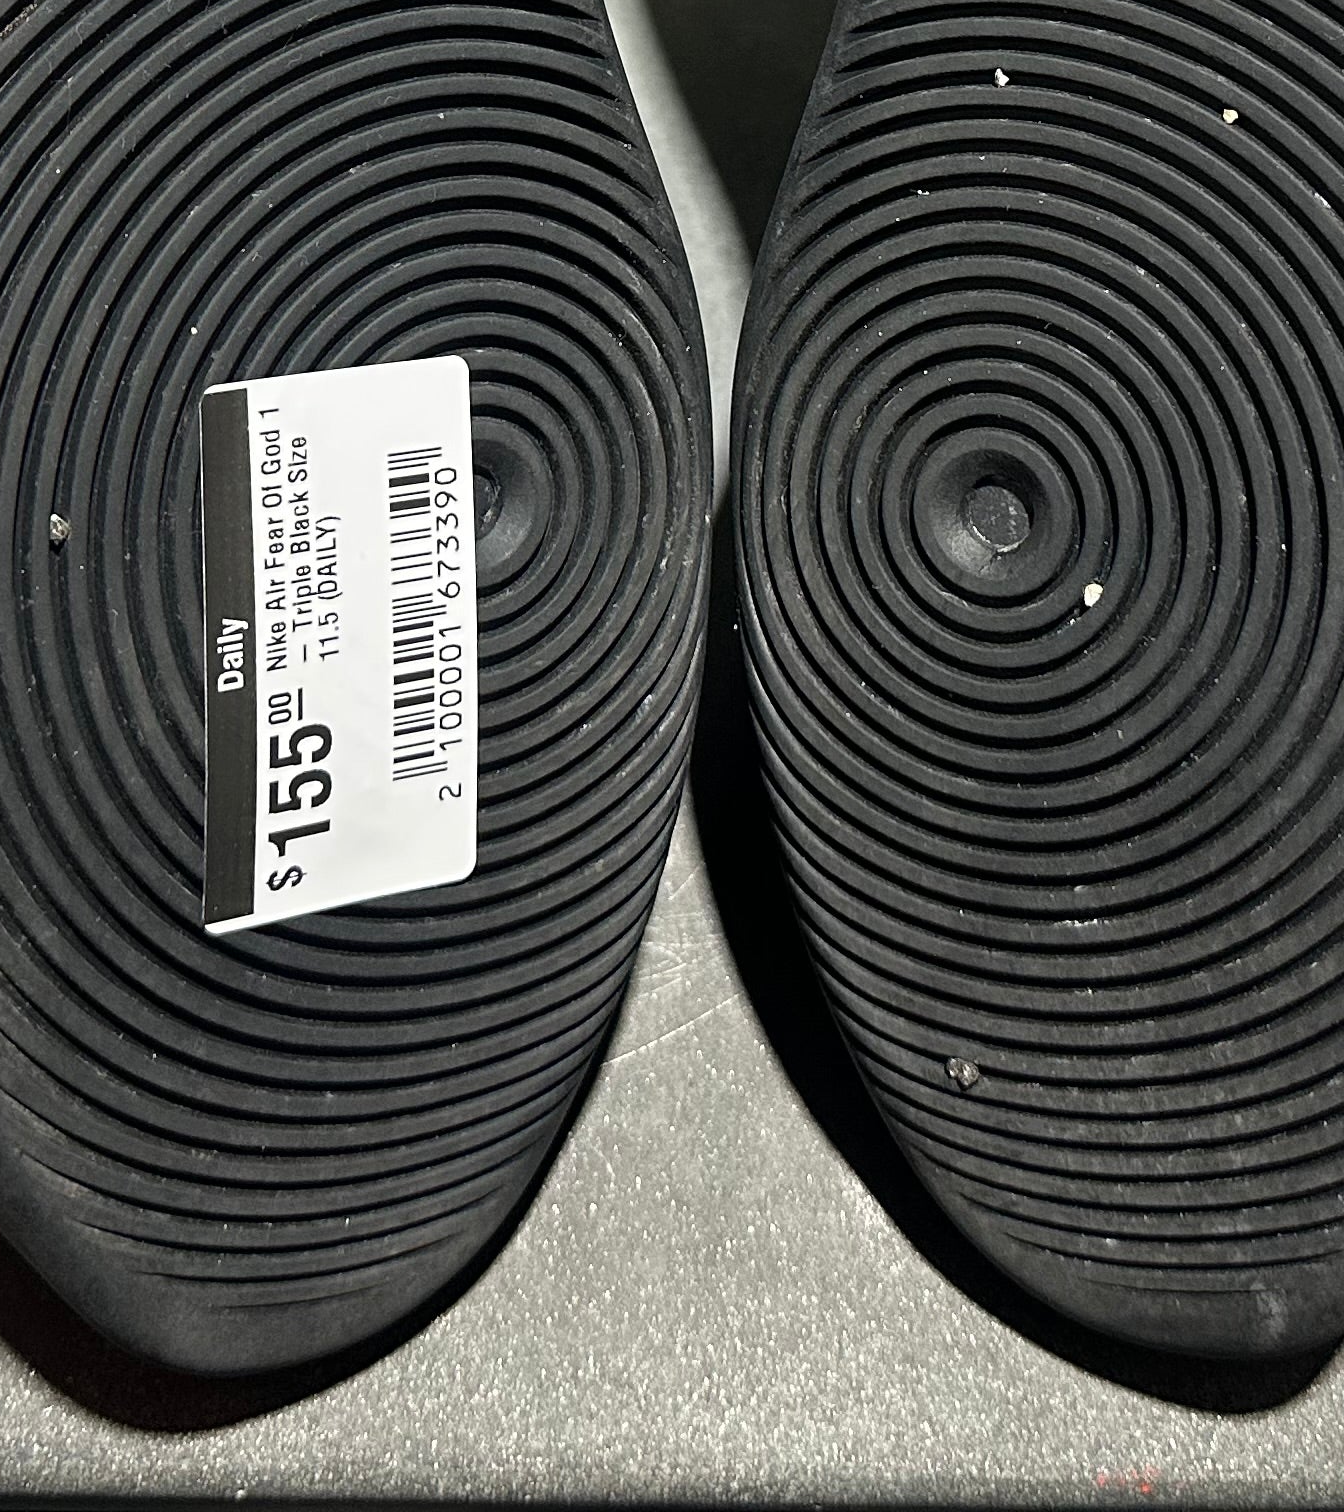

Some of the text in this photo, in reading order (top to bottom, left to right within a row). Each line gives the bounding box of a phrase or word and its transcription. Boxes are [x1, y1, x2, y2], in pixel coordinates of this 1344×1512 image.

[286, 435, 308, 484] Size
[257, 407, 288, 672] Nike Air Fear Of God 1
[288, 490, 311, 555] Black
[291, 564, 313, 632] Triple
[315, 515, 343, 662] 11.5 (DAILY)
[216, 617, 249, 693] Daily
[434, 466, 463, 800] 2 100001 673390
